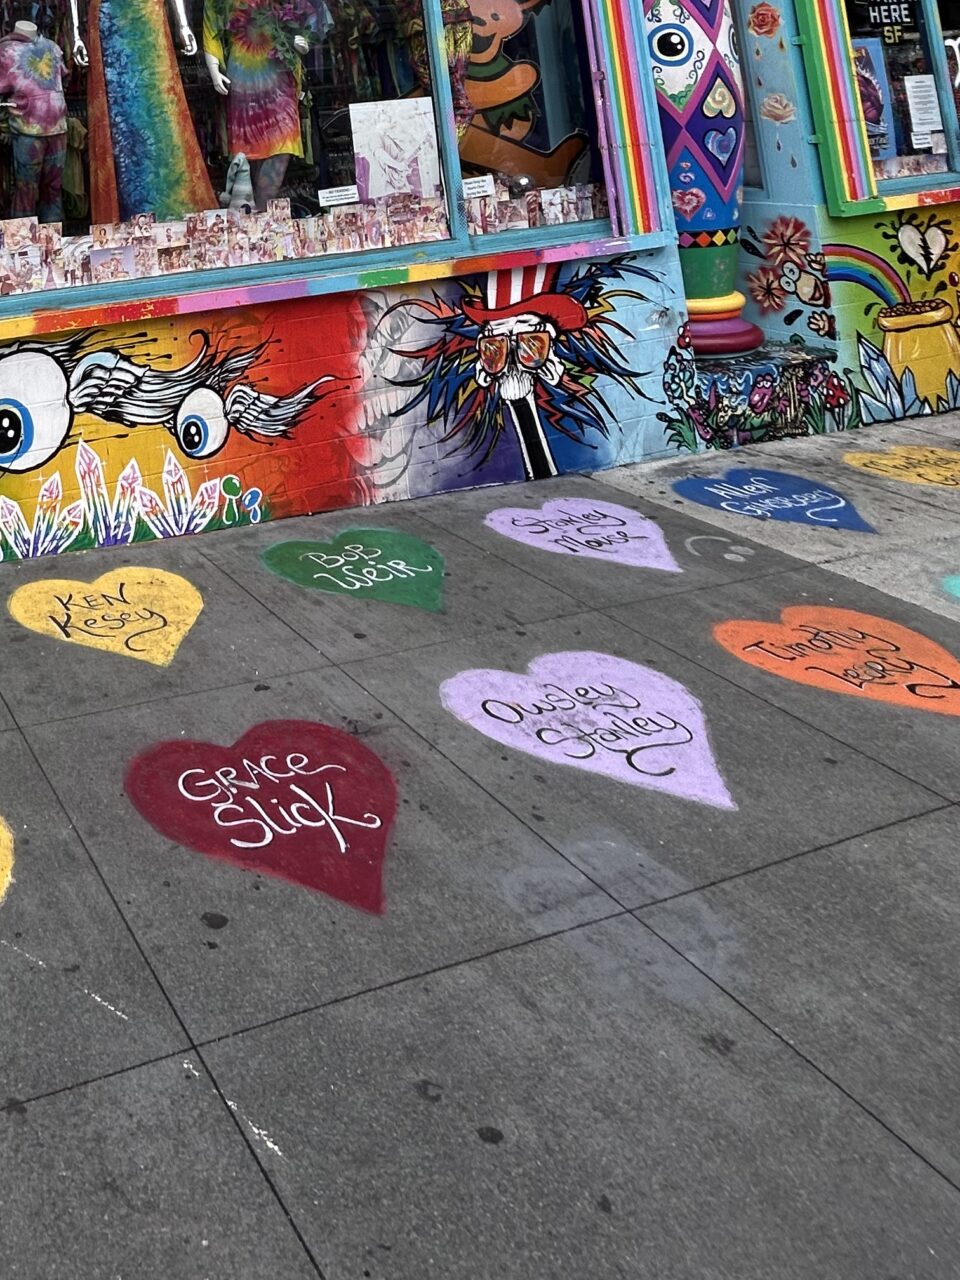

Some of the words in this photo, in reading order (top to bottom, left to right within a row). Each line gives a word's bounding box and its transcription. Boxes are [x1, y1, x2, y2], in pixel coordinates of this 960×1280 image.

[869, 4, 911, 23] HERE
[884, 25, 902, 44] SF
[704, 475, 781, 500] Allen
[547, 530, 649, 554] Mouse
[54, 582, 131, 613] KEN
[481, 682, 641, 724] Owsley
[535, 711, 694, 777] Stanley
